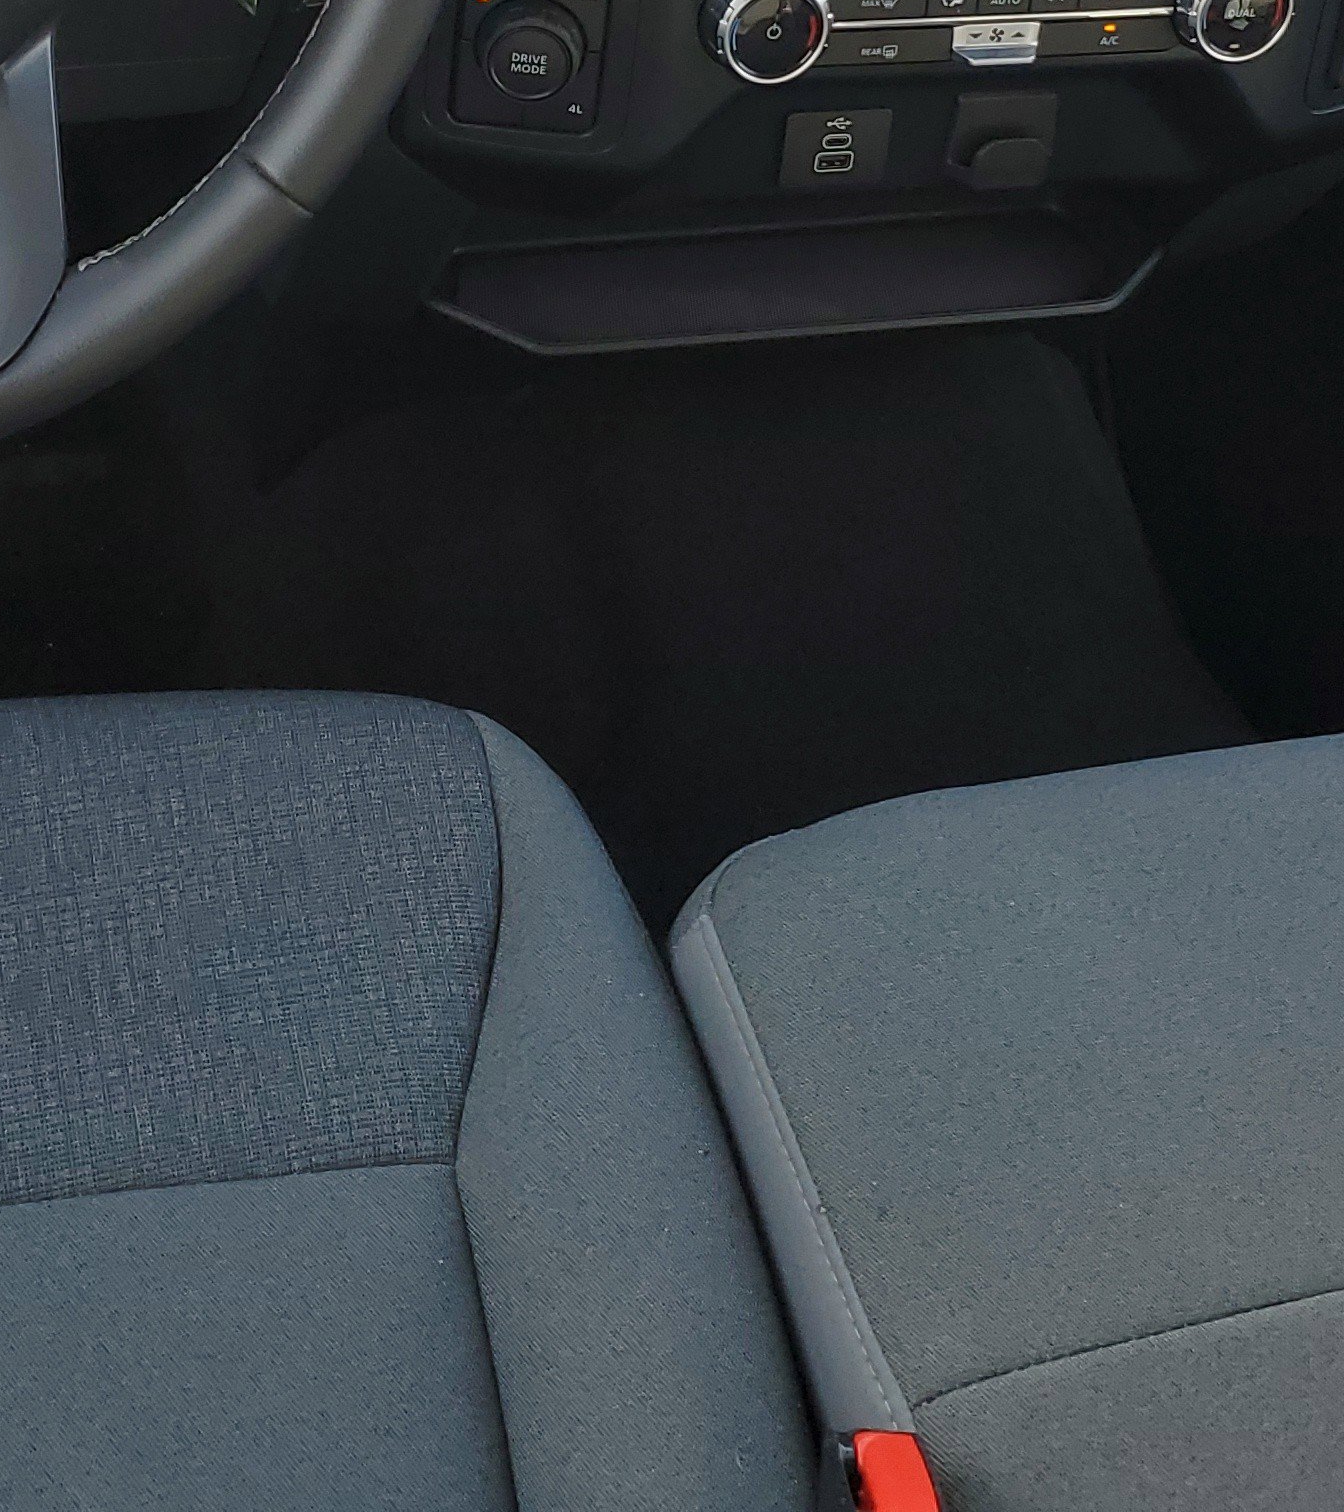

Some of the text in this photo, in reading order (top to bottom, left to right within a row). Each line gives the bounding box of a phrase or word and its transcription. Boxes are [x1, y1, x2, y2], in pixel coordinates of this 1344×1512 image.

[1227, 8, 1256, 18] DUAL
[1099, 35, 1119, 45] A/C
[511, 52, 548, 65] DRIVE
[510, 63, 547, 75] MODE
[568, 104, 583, 115] 4L
